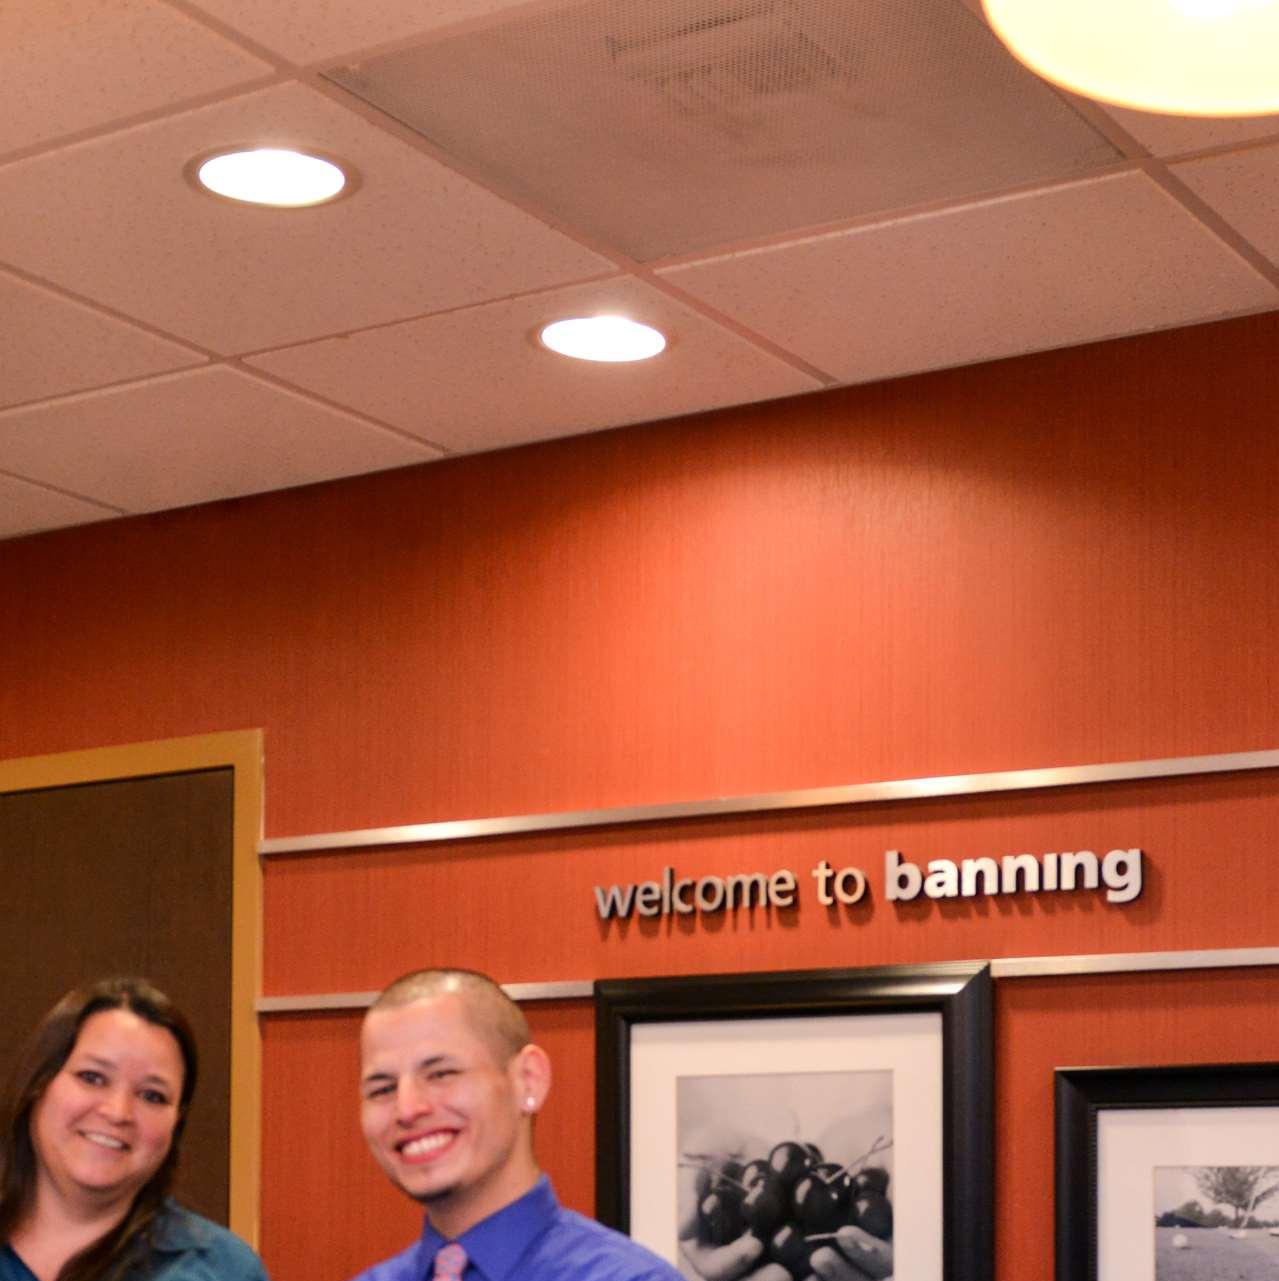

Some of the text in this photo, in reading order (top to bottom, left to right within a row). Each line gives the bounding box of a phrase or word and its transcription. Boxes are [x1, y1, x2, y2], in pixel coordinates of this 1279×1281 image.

[594, 846, 1143, 920] welcome to banning
